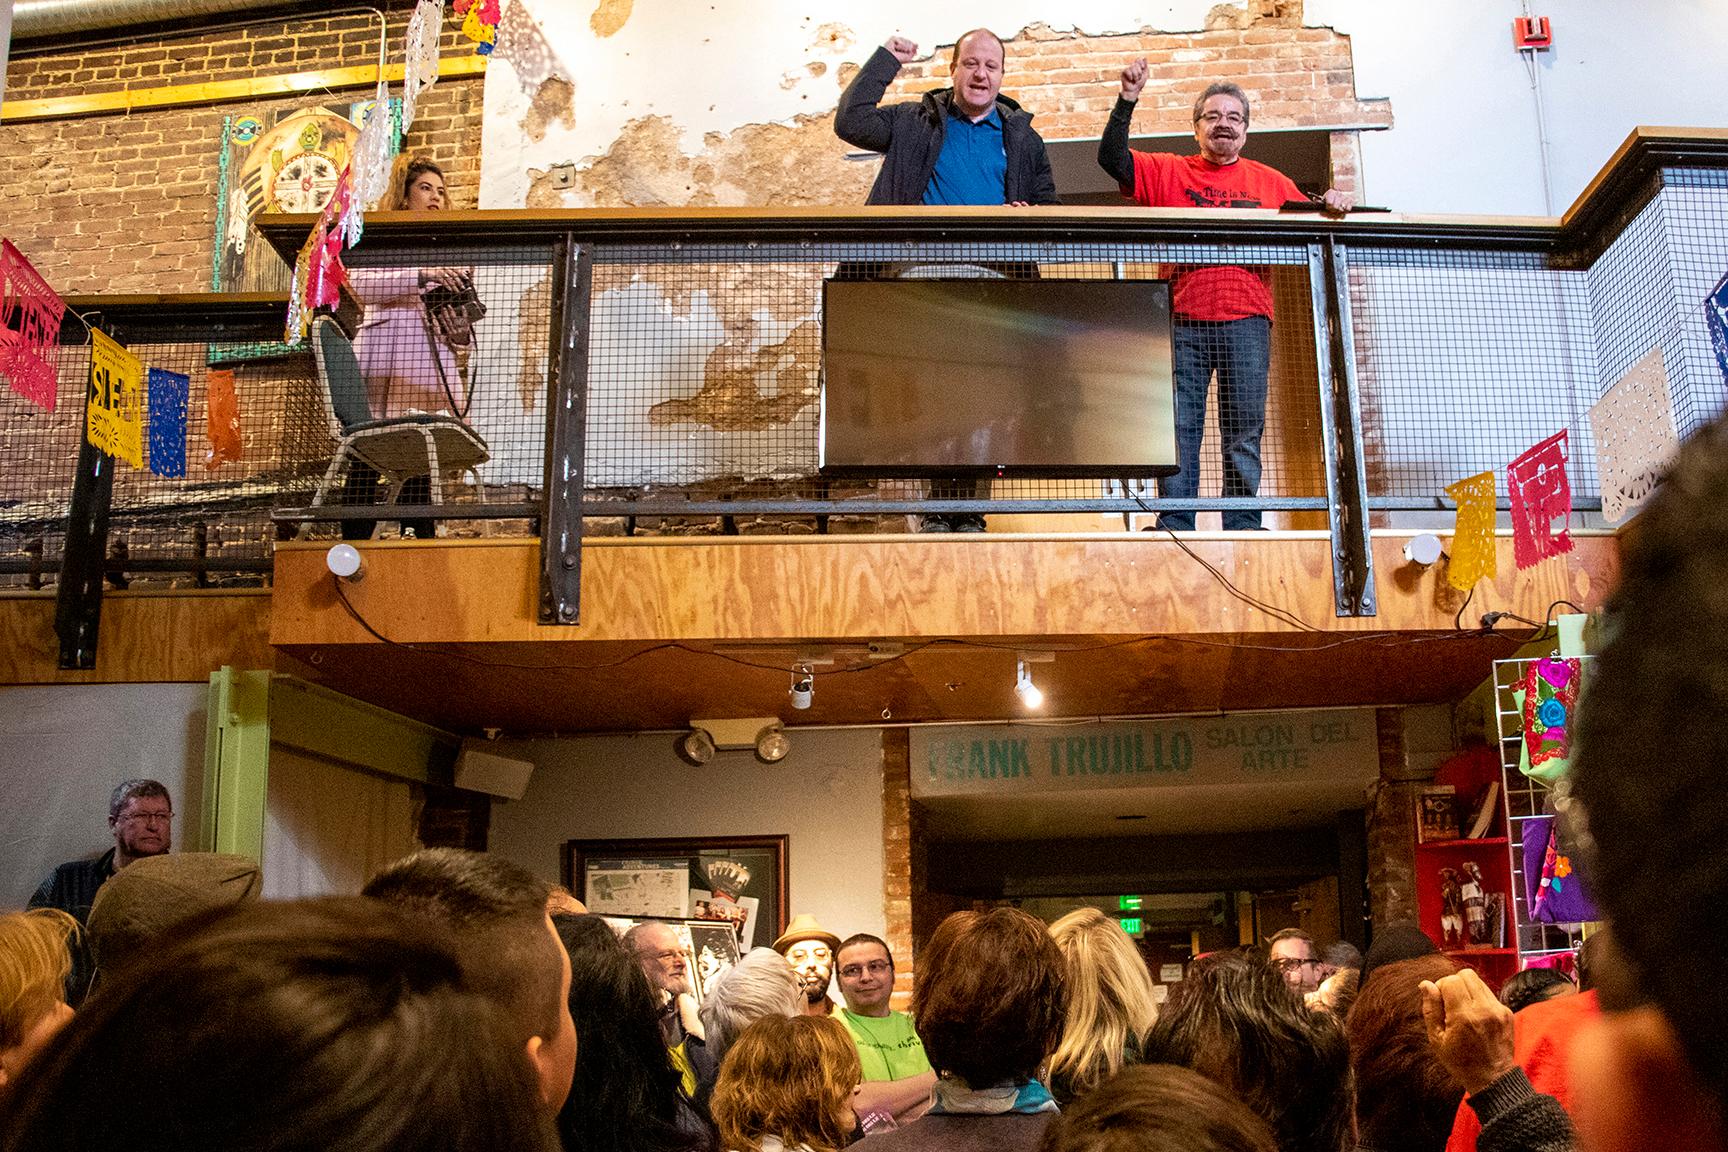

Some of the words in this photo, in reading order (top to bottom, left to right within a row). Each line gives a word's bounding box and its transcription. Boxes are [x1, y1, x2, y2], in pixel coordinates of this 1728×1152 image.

[1205, 725, 1296, 748] SALON
[1311, 722, 1360, 743] DEL
[928, 738, 1031, 780] FRANK
[1045, 732, 1193, 776] TRUJILLO
[1241, 749, 1309, 769] ARTE
